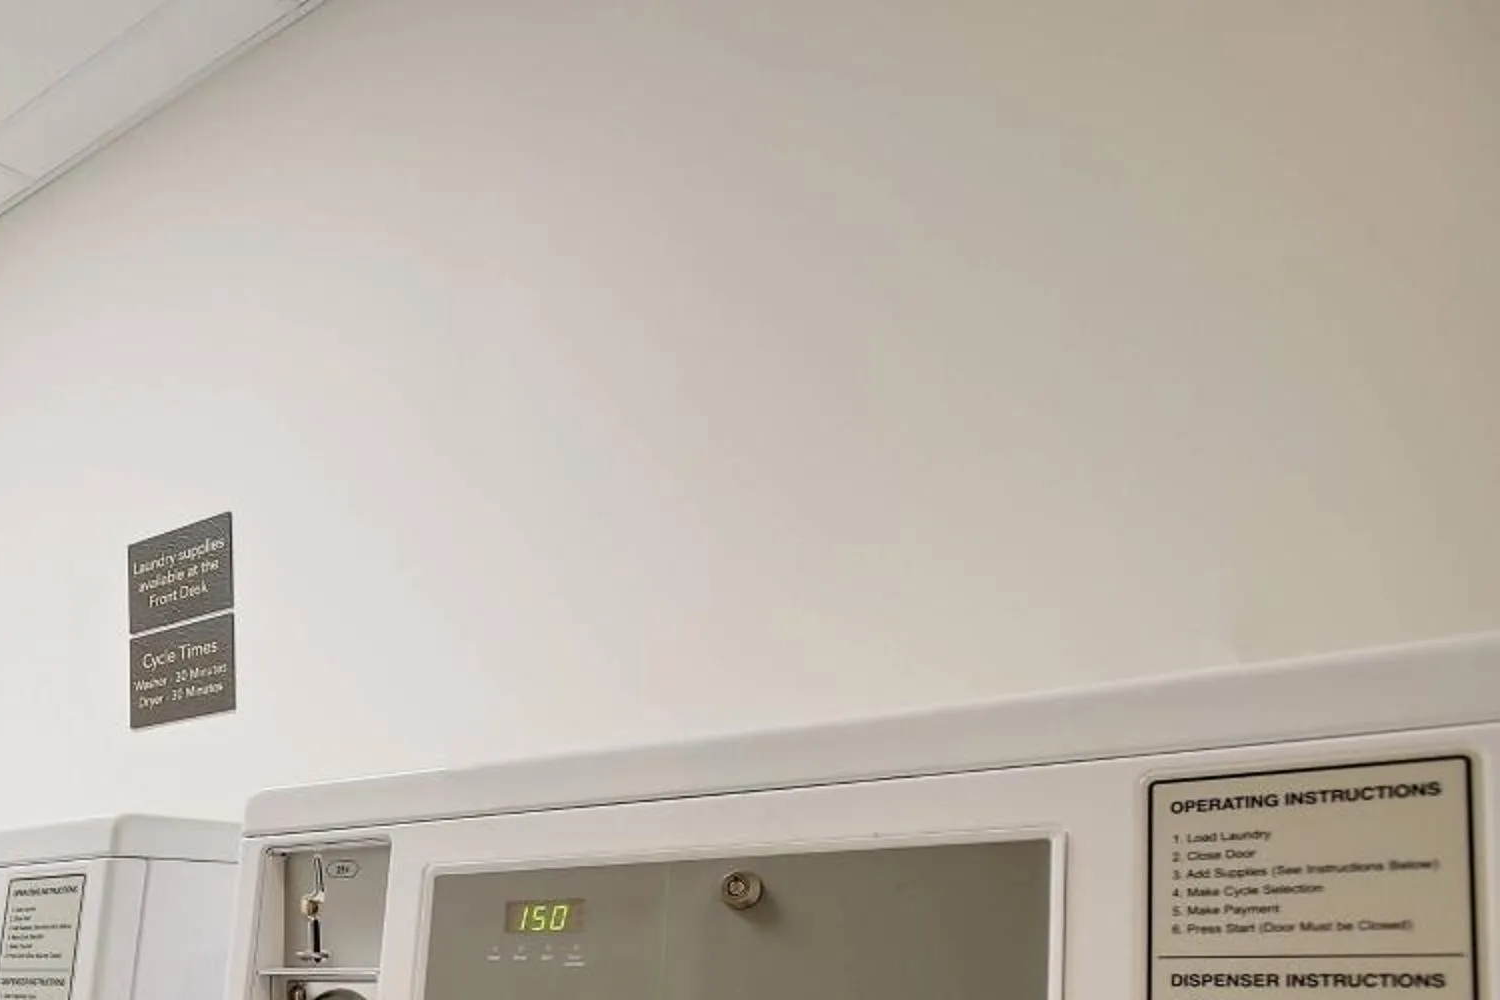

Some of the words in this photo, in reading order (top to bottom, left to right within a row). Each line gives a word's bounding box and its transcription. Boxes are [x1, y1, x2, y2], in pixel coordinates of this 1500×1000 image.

[133, 552, 175, 576] Laundry
[178, 537, 225, 562] supplies
[138, 570, 184, 593] available
[187, 564, 198, 579] at
[200, 559, 219, 573] the
[148, 590, 177, 609] Front
[179, 578, 209, 600] Desk
[142, 649, 175, 672] Cycle
[179, 641, 218, 661] Times
[133, 677, 167, 692] Washer
[189, 663, 227, 681] Minutes
[138, 695, 164, 710] Dryer
[1170, 793, 1279, 814] OPERATING
[1284, 781, 1442, 806] INSTRUCTIONS
[1186, 832, 1218, 843] Load
[1220, 830, 1272, 843] Laundry
[1186, 851, 1221, 861] Close
[1225, 848, 1257, 860] Door
[1186, 868, 1210, 879] Add
[1213, 866, 1268, 880] Supplies
[1306, 861, 1384, 874] Instructions
[1187, 887, 1219, 897] Make
[1223, 885, 1259, 898] Cycle
[1262, 883, 1325, 895] Selection
[518, 904, 568, 931] 150
[1187, 905, 1220, 915] Make
[1224, 904, 1280, 915] Payment
[1187, 923, 1222, 934] Press
[1226, 922, 1255, 934] Start
[1259, 921, 1295, 935] (Door
[1299, 920, 1333, 932] Must
[1336, 920, 1353, 932] be
[1170, 973, 1279, 988] DISPENSER
[1285, 972, 1446, 989] INSTRUCTIONS
